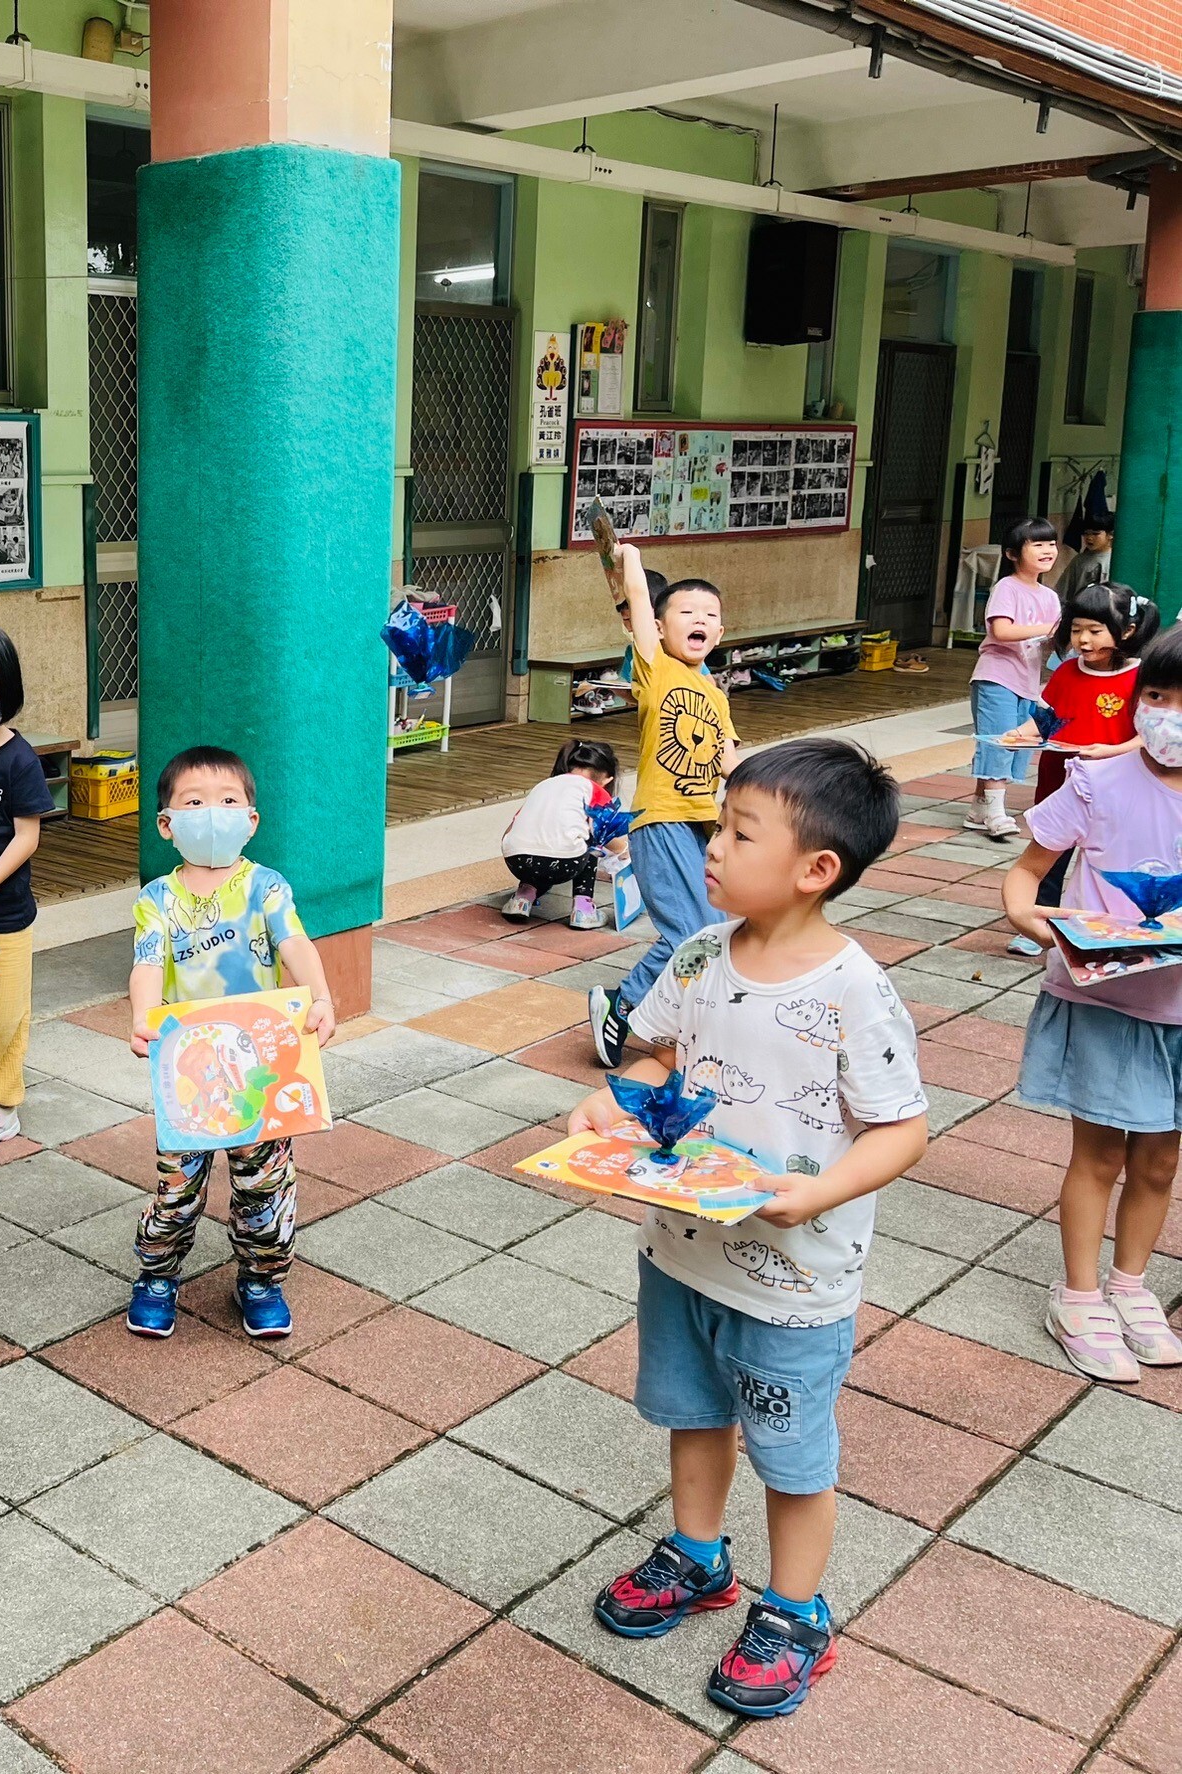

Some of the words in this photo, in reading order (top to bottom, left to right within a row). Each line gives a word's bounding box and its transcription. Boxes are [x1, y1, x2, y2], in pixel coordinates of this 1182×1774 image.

[539, 405, 562, 418] 孔雀班
[539, 418, 560, 426] Peacock
